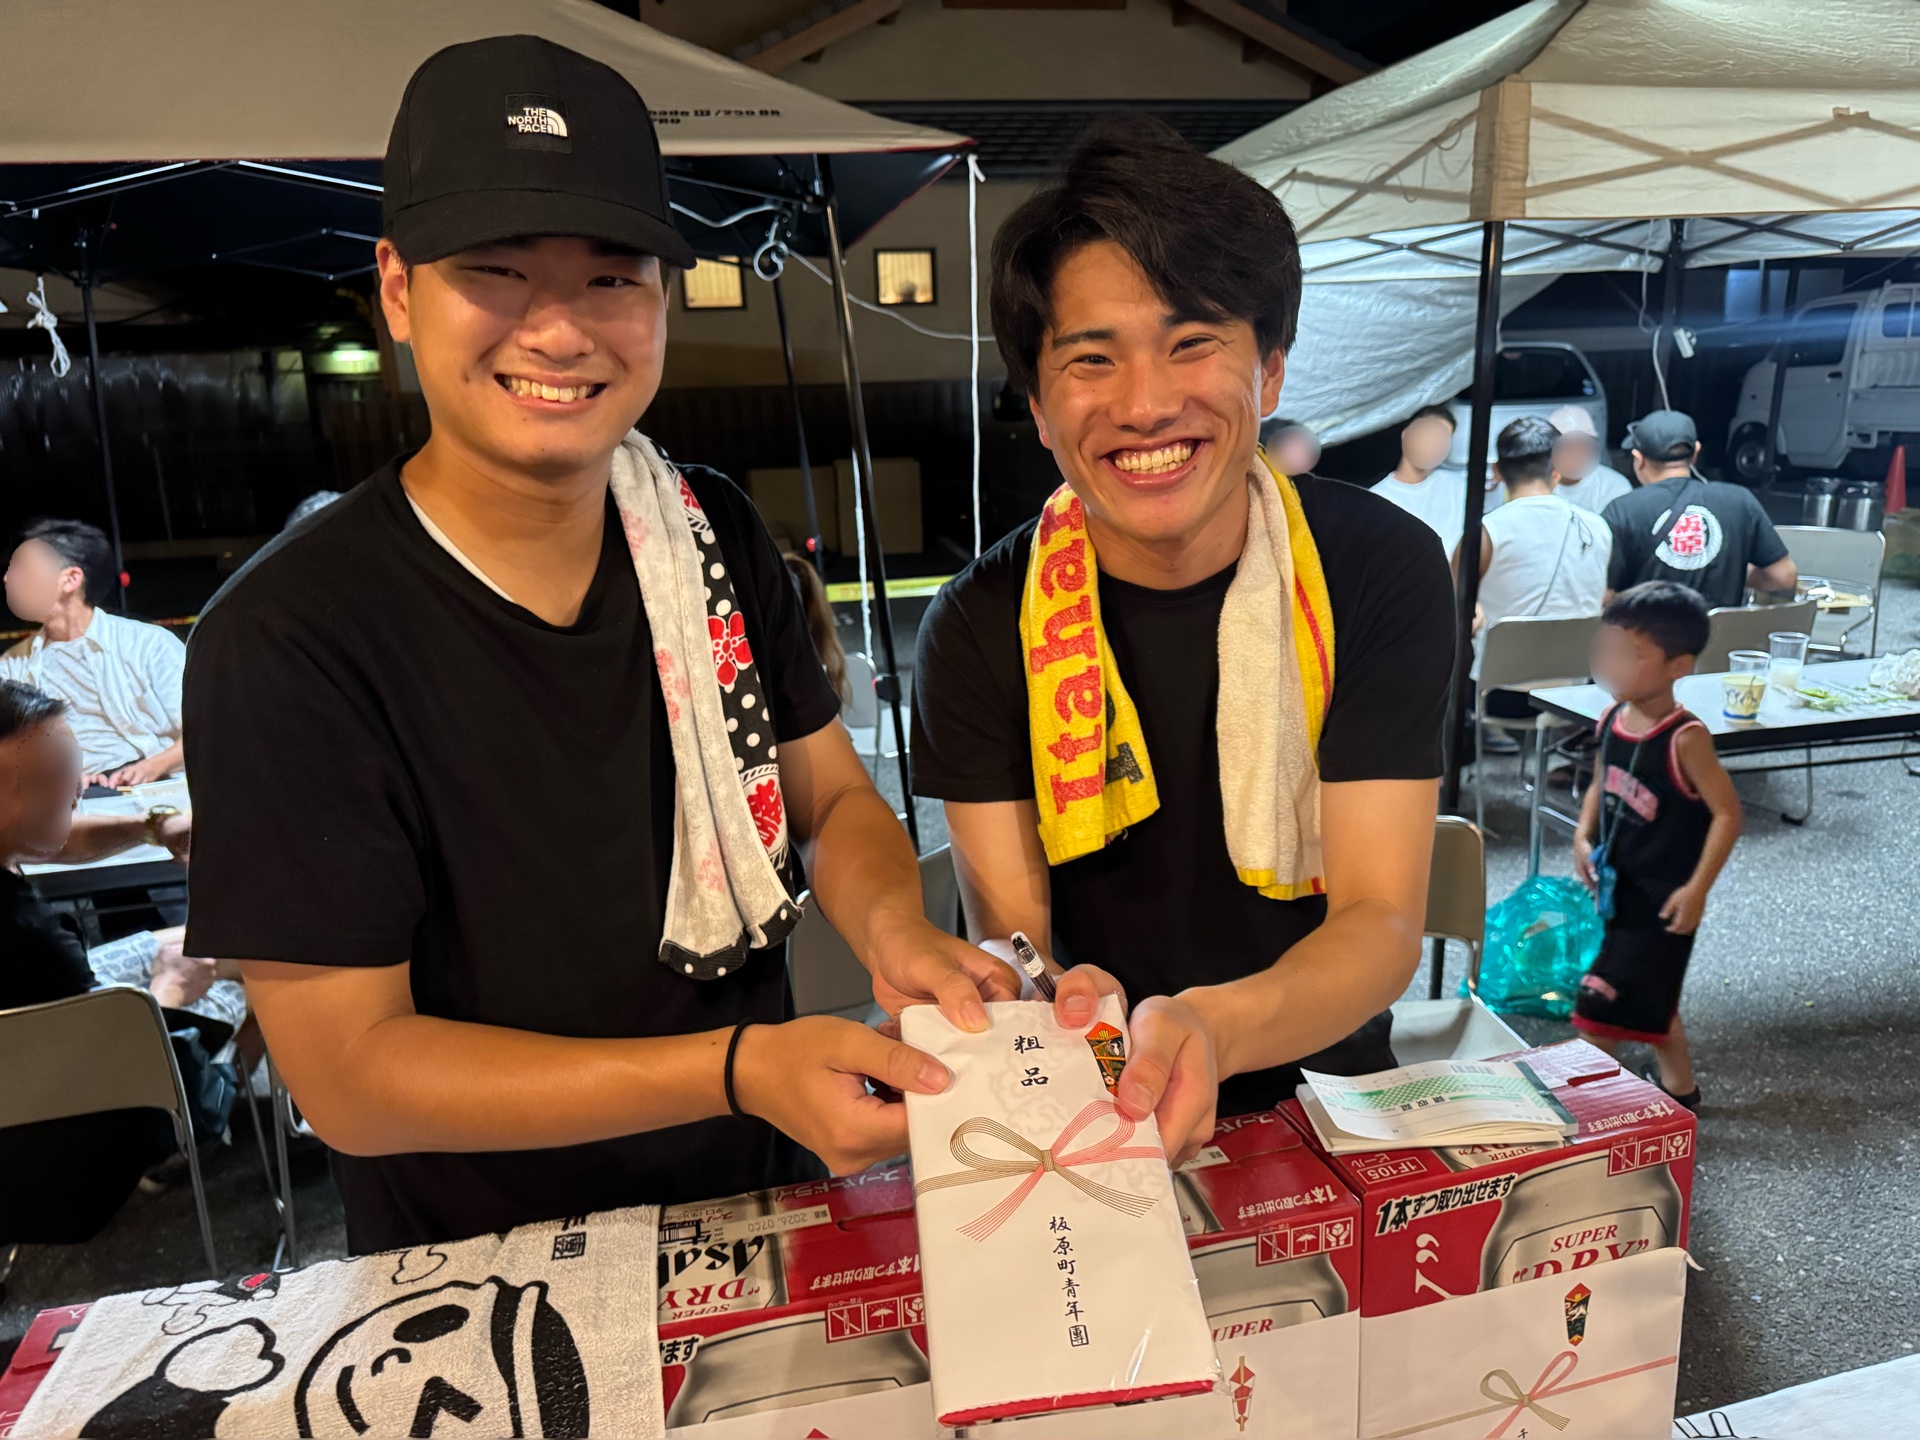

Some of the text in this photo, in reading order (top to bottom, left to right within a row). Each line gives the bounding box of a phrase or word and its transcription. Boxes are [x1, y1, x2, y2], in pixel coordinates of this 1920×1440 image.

[507, 116, 547, 125] NORTH
[523, 107, 547, 116] THE
[518, 124, 548, 133] FACE
[1030, 484, 1106, 815] Itahar
[1014, 1035, 1049, 1087] 粗品
[1352, 1153, 1391, 1169] ビール
[775, 1169, 900, 1202] スーパードライ
[1237, 1184, 1338, 1219] 1本ずつ取り出せます
[1377, 1174, 1516, 1234] 1本ずつ取り出せます
[1550, 1224, 1619, 1253] SUPER
[809, 1253, 921, 1291] 1本ずつ取り出せます
[672, 1303, 731, 1321] SUPER
[1211, 1318, 1274, 1343] UPER
